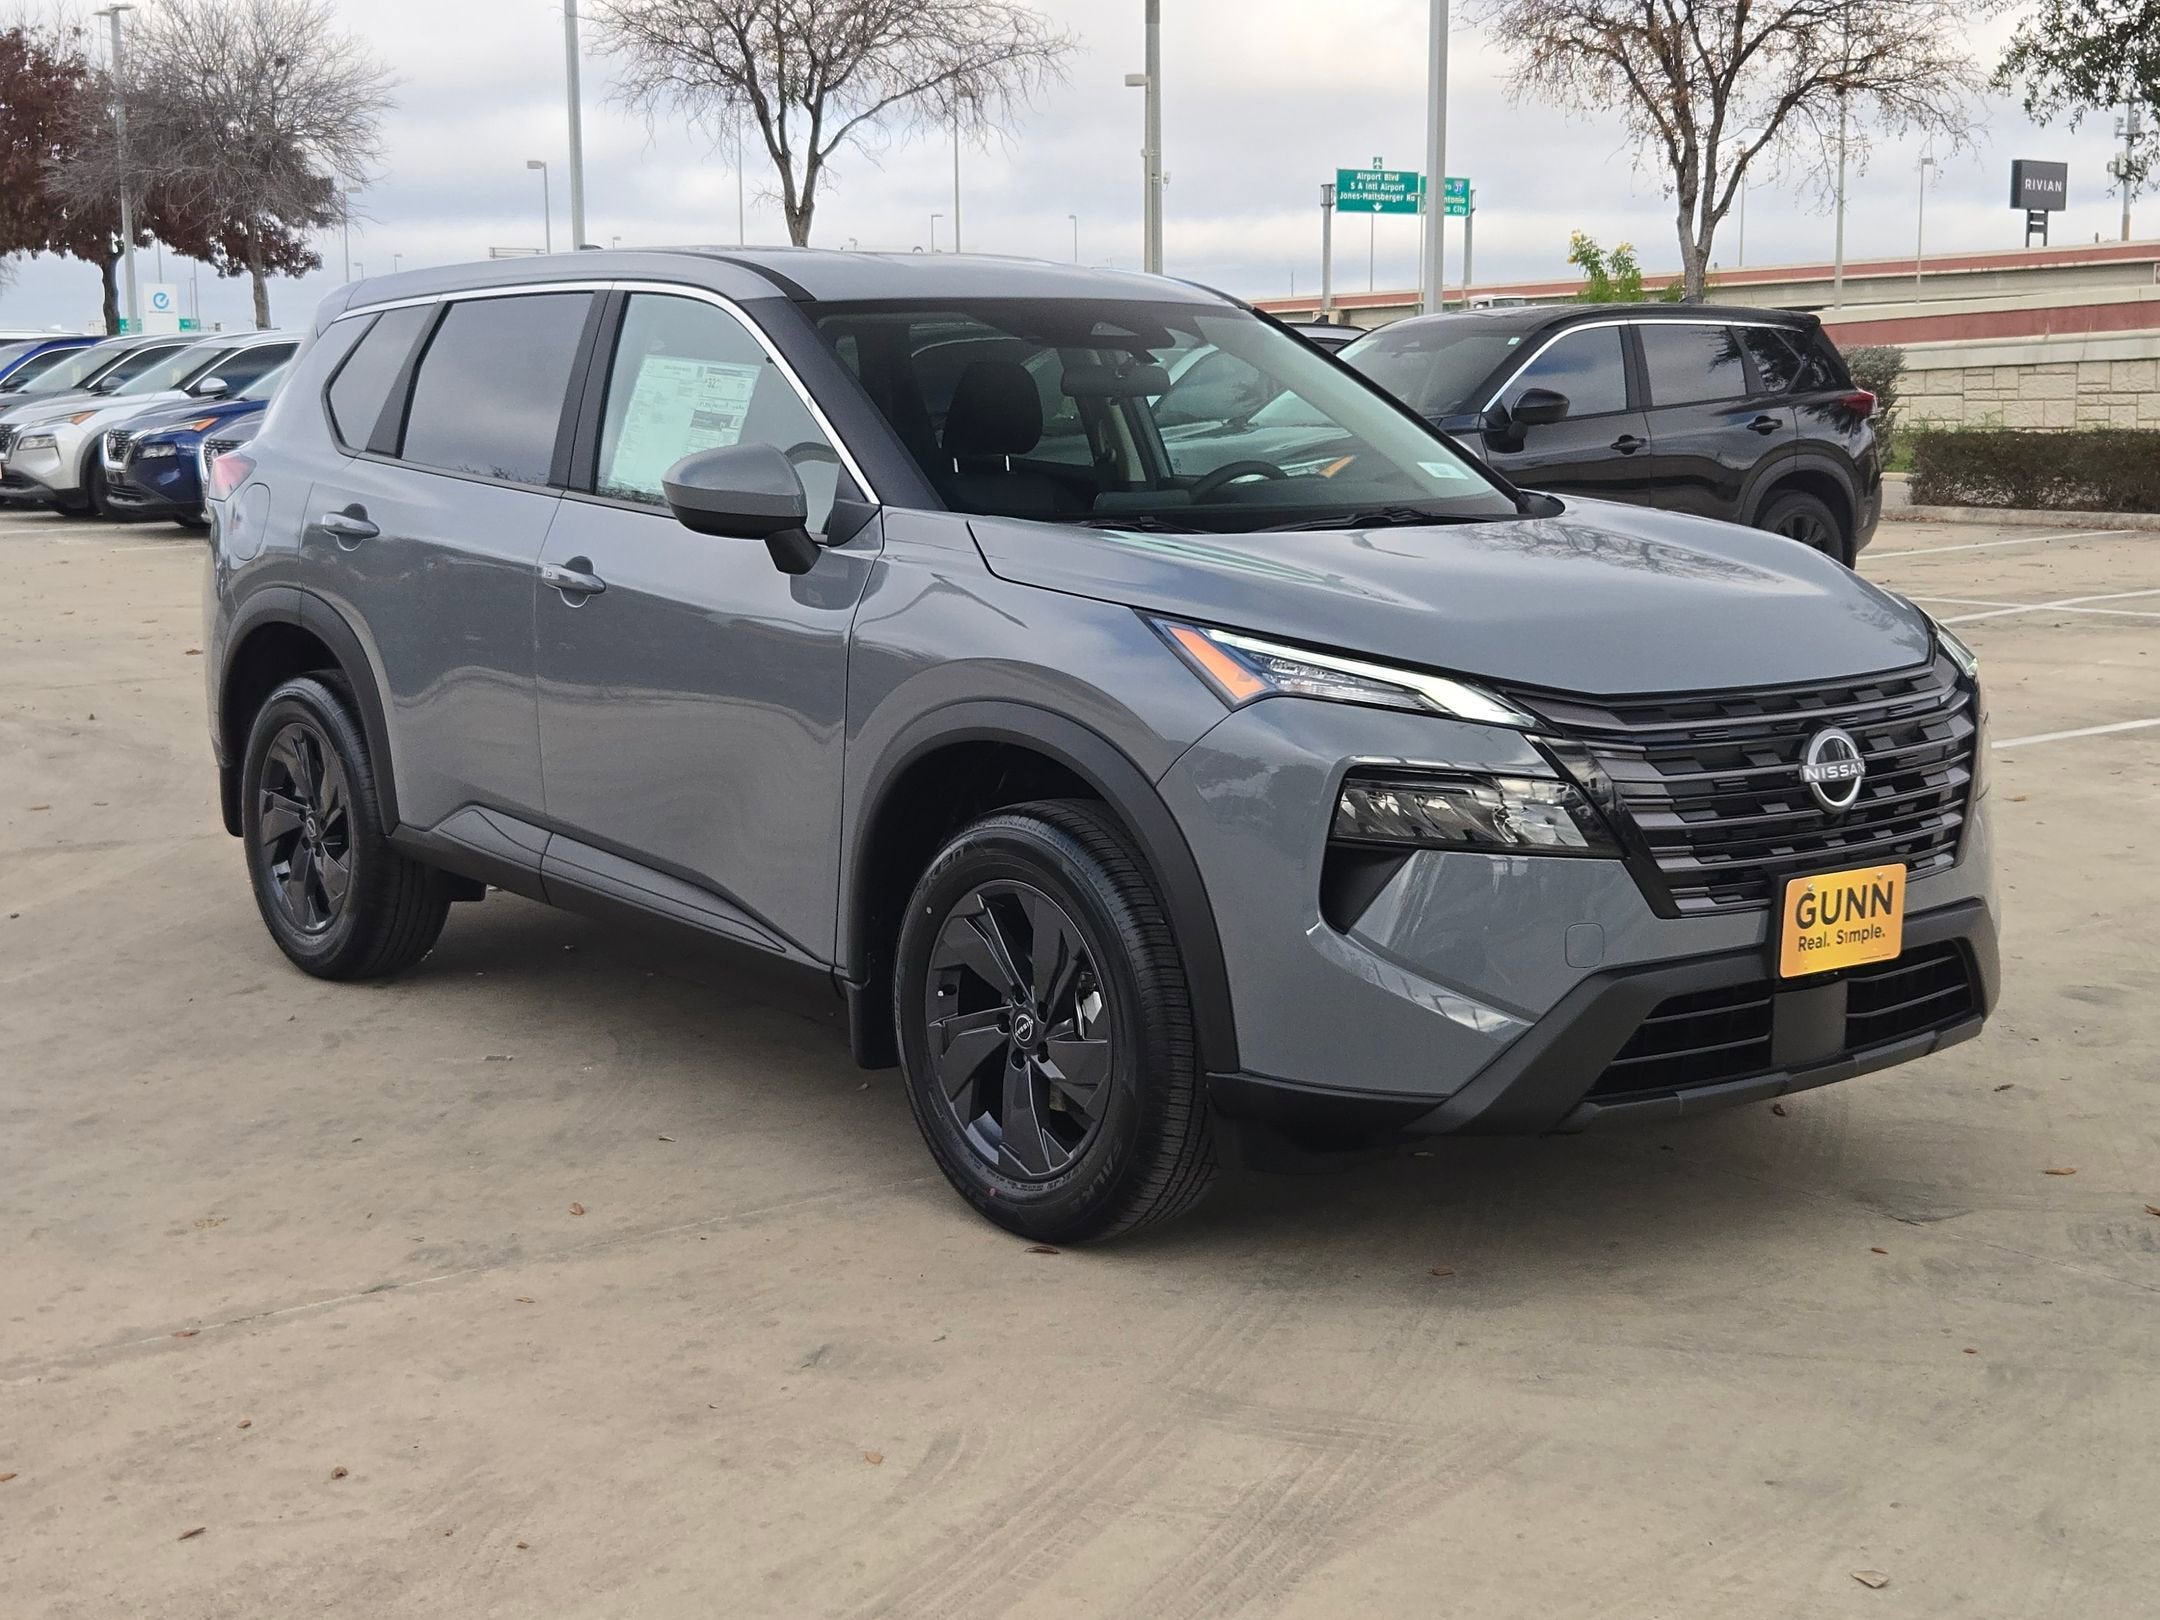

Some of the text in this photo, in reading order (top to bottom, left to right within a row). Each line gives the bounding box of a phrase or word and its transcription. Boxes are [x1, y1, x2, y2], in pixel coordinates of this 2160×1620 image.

[1356, 173, 1399, 181] Airport Blvd
[1350, 182, 1355, 190] S
[1358, 182, 1363, 190] A
[1380, 184, 1405, 192] Airport
[2025, 178, 2062, 192] RIVIAN
[1453, 205, 1467, 215] City
[1806, 761, 1865, 780] NISSAN
[1795, 881, 1894, 929] GUNN
[1798, 932, 1830, 952] Real.
